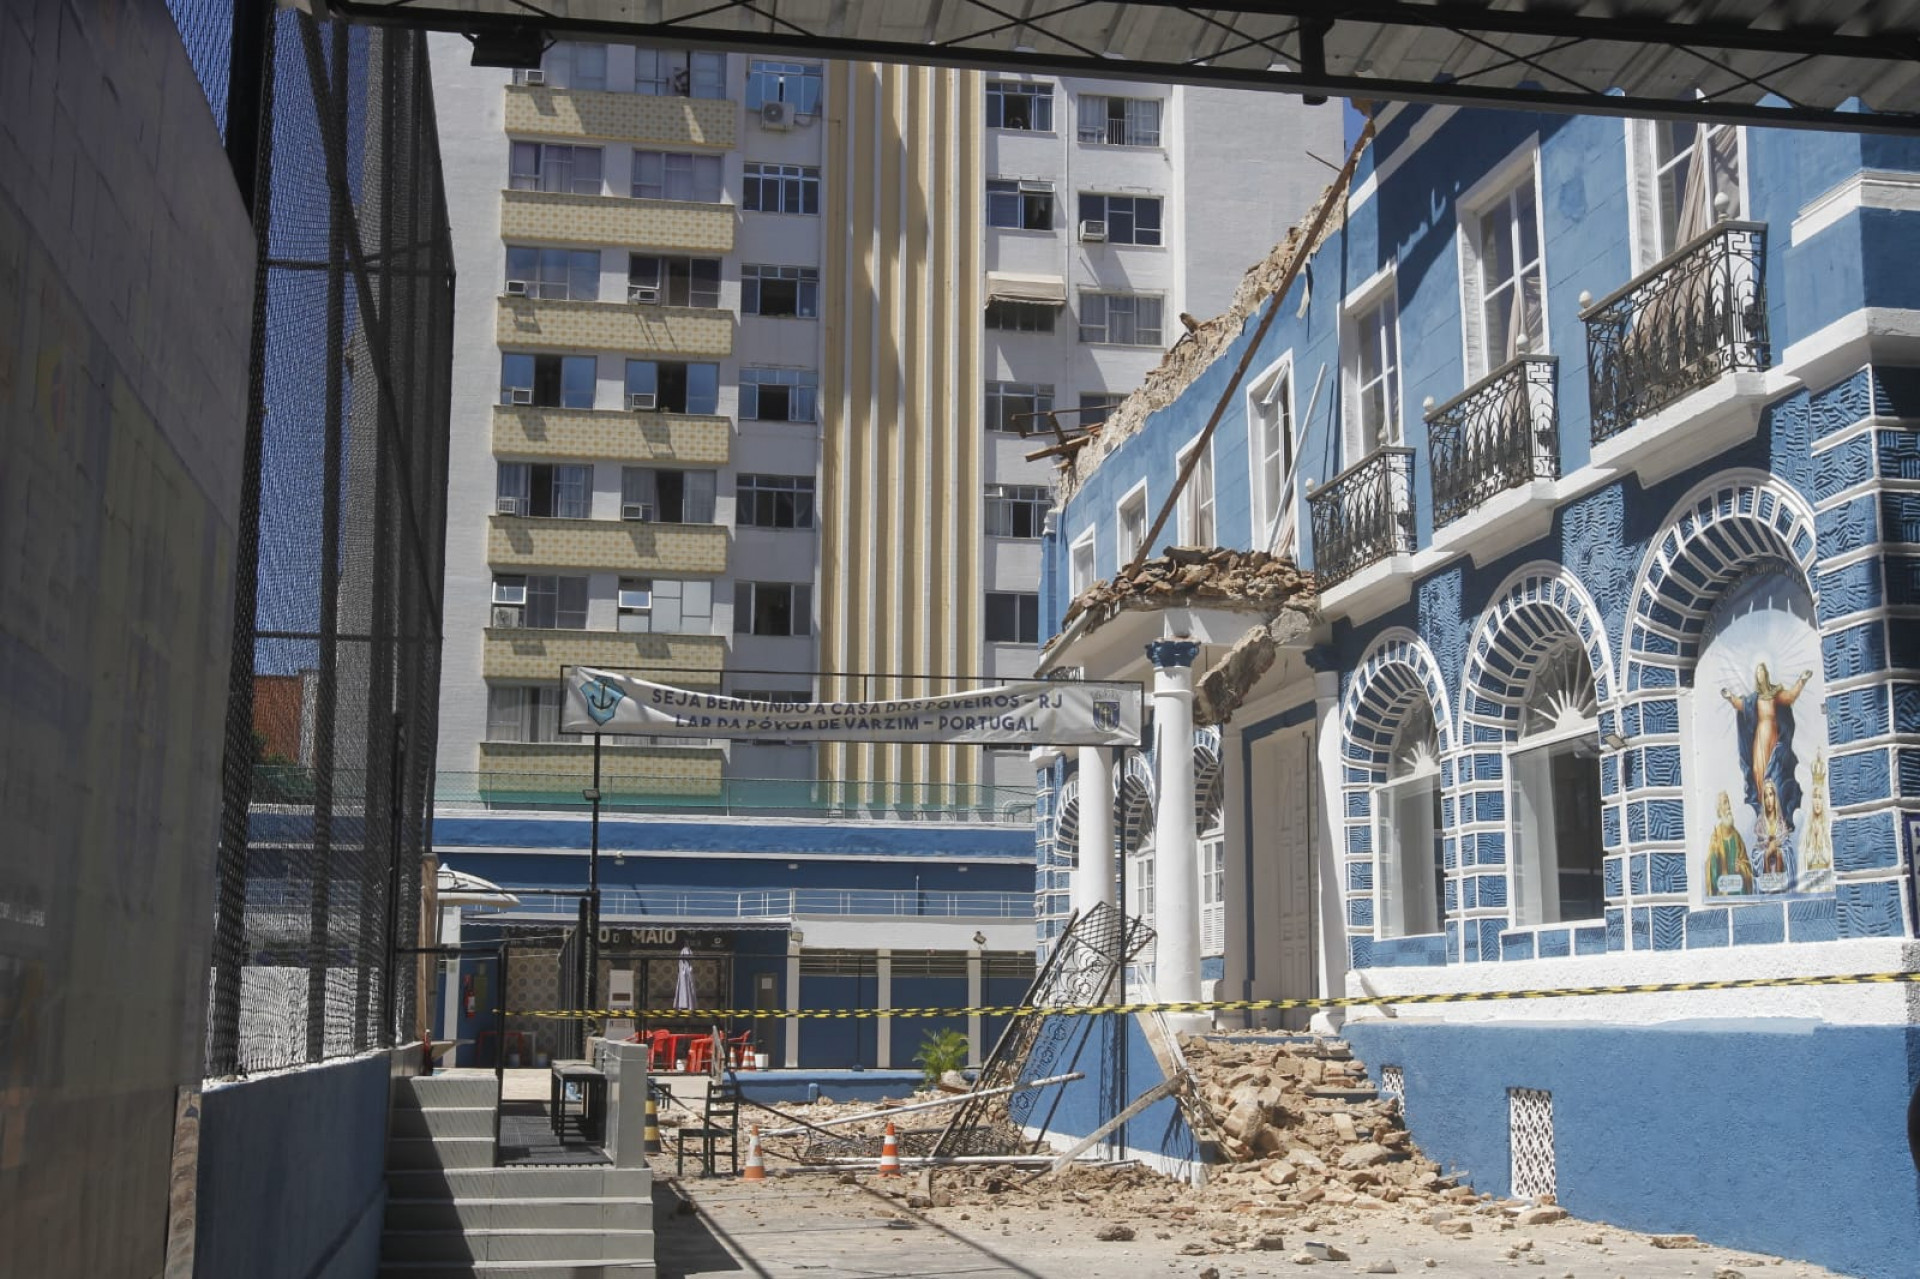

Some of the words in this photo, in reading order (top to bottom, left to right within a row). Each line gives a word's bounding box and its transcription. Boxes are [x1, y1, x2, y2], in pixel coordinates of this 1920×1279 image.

[652, 689, 701, 708] SEJA
[707, 695, 745, 711] BEM
[752, 700, 809, 715] VINDO
[814, 704, 826, 715] A
[831, 703, 880, 716] CASA
[886, 701, 919, 714] DOS
[925, 694, 1020, 713] POVEIROS
[1040, 694, 1063, 710] RJ
[675, 713, 711, 729] LAR
[717, 717, 740, 730] DA
[817, 717, 840, 730] DE
[844, 717, 919, 730] VARZIM
[939, 714, 1039, 731] PORTUGAL
[632, 928, 676, 944] MAIO
